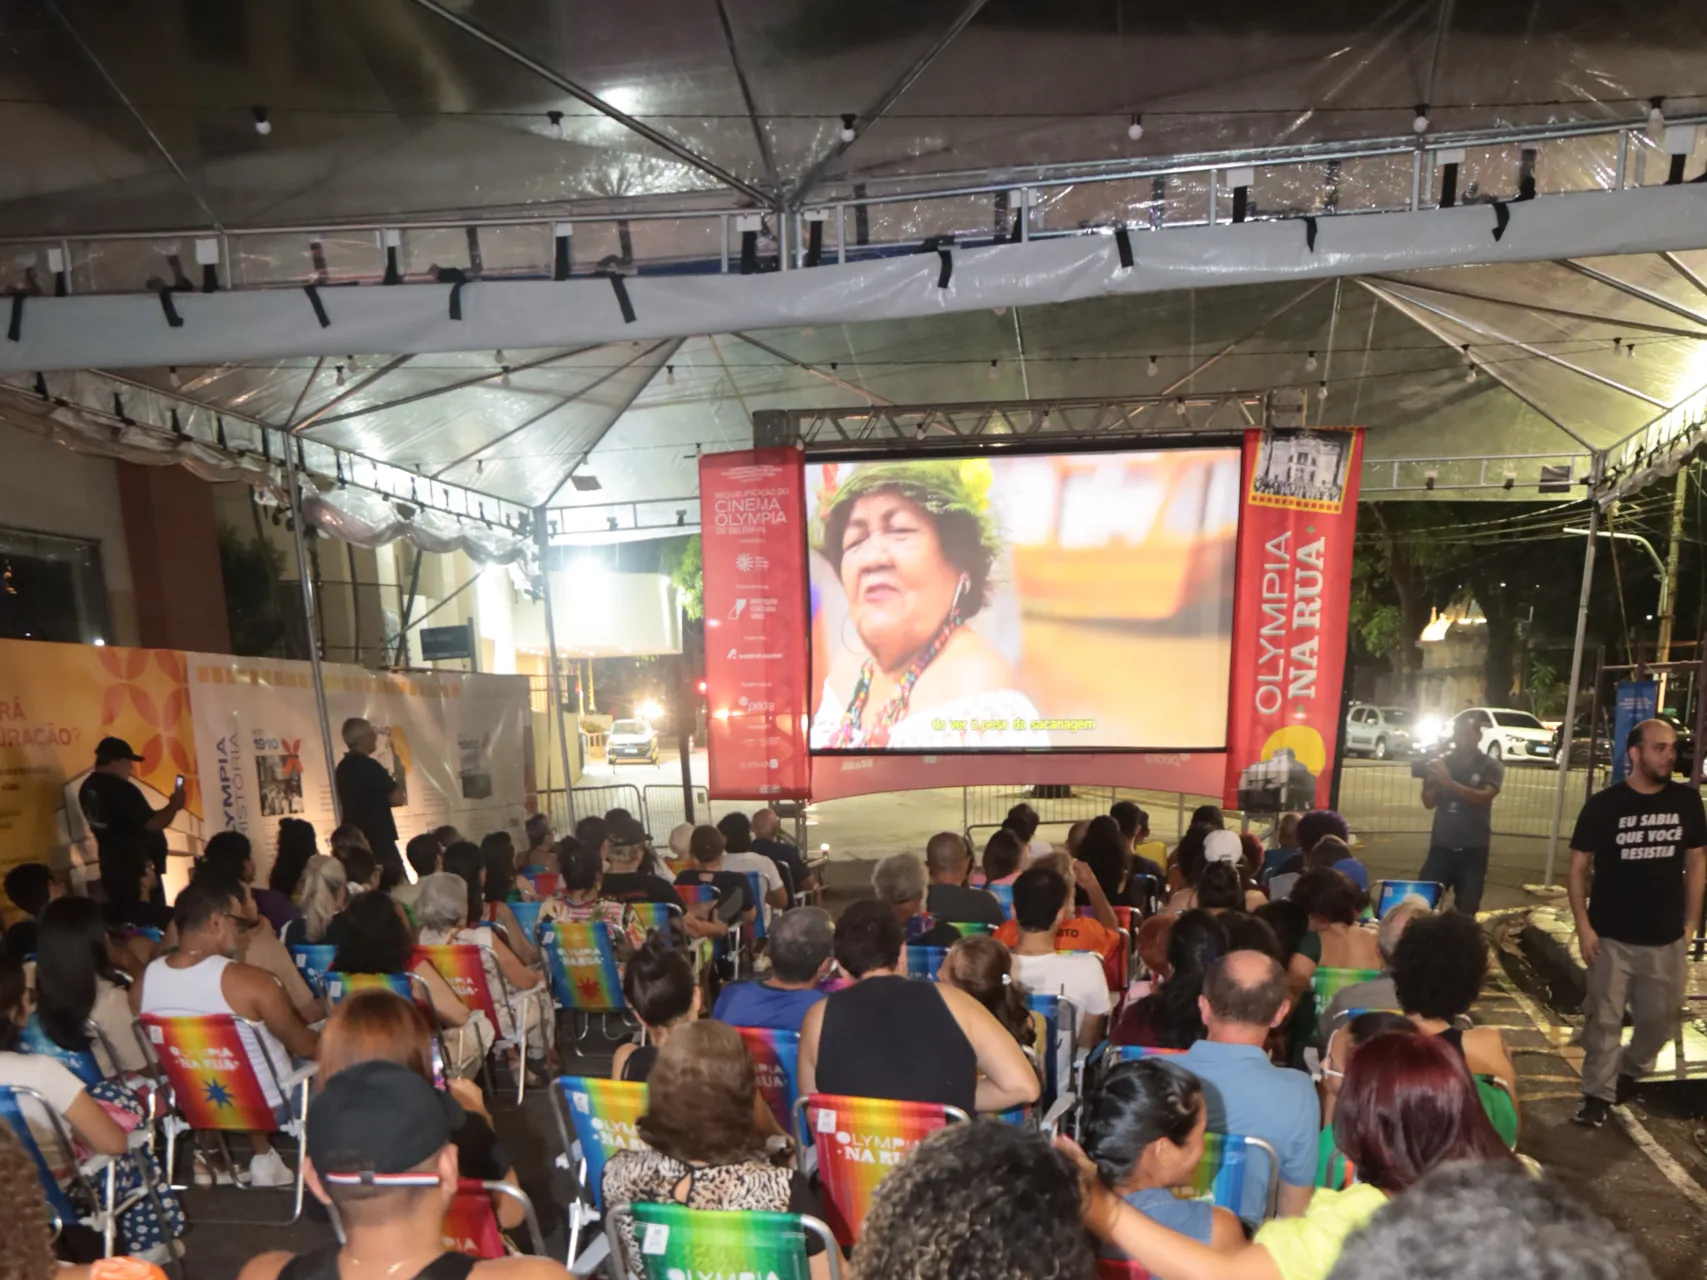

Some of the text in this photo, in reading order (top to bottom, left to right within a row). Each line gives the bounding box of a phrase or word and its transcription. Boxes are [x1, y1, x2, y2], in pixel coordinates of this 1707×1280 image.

[715, 498, 781, 513] CINEMA
[715, 511, 788, 526] OLYMPIA
[1255, 531, 1292, 715] OLYMPIA
[1288, 536, 1326, 700] NA RUA
[931, 717, 946, 731] do
[950, 719, 967, 731] ver
[981, 719, 1009, 733] peso
[1012, 716, 1027, 731] da
[1030, 718, 1096, 733] sacanagem
[254, 738, 279, 750] 1910
[215, 736, 236, 832] YMPIA
[1618, 812, 1680, 829] EU SABIA
[1615, 826, 1683, 845] QUE VOCÊ
[1621, 845, 1675, 860] RESISTIA
[843, 1146, 876, 1165] NA
